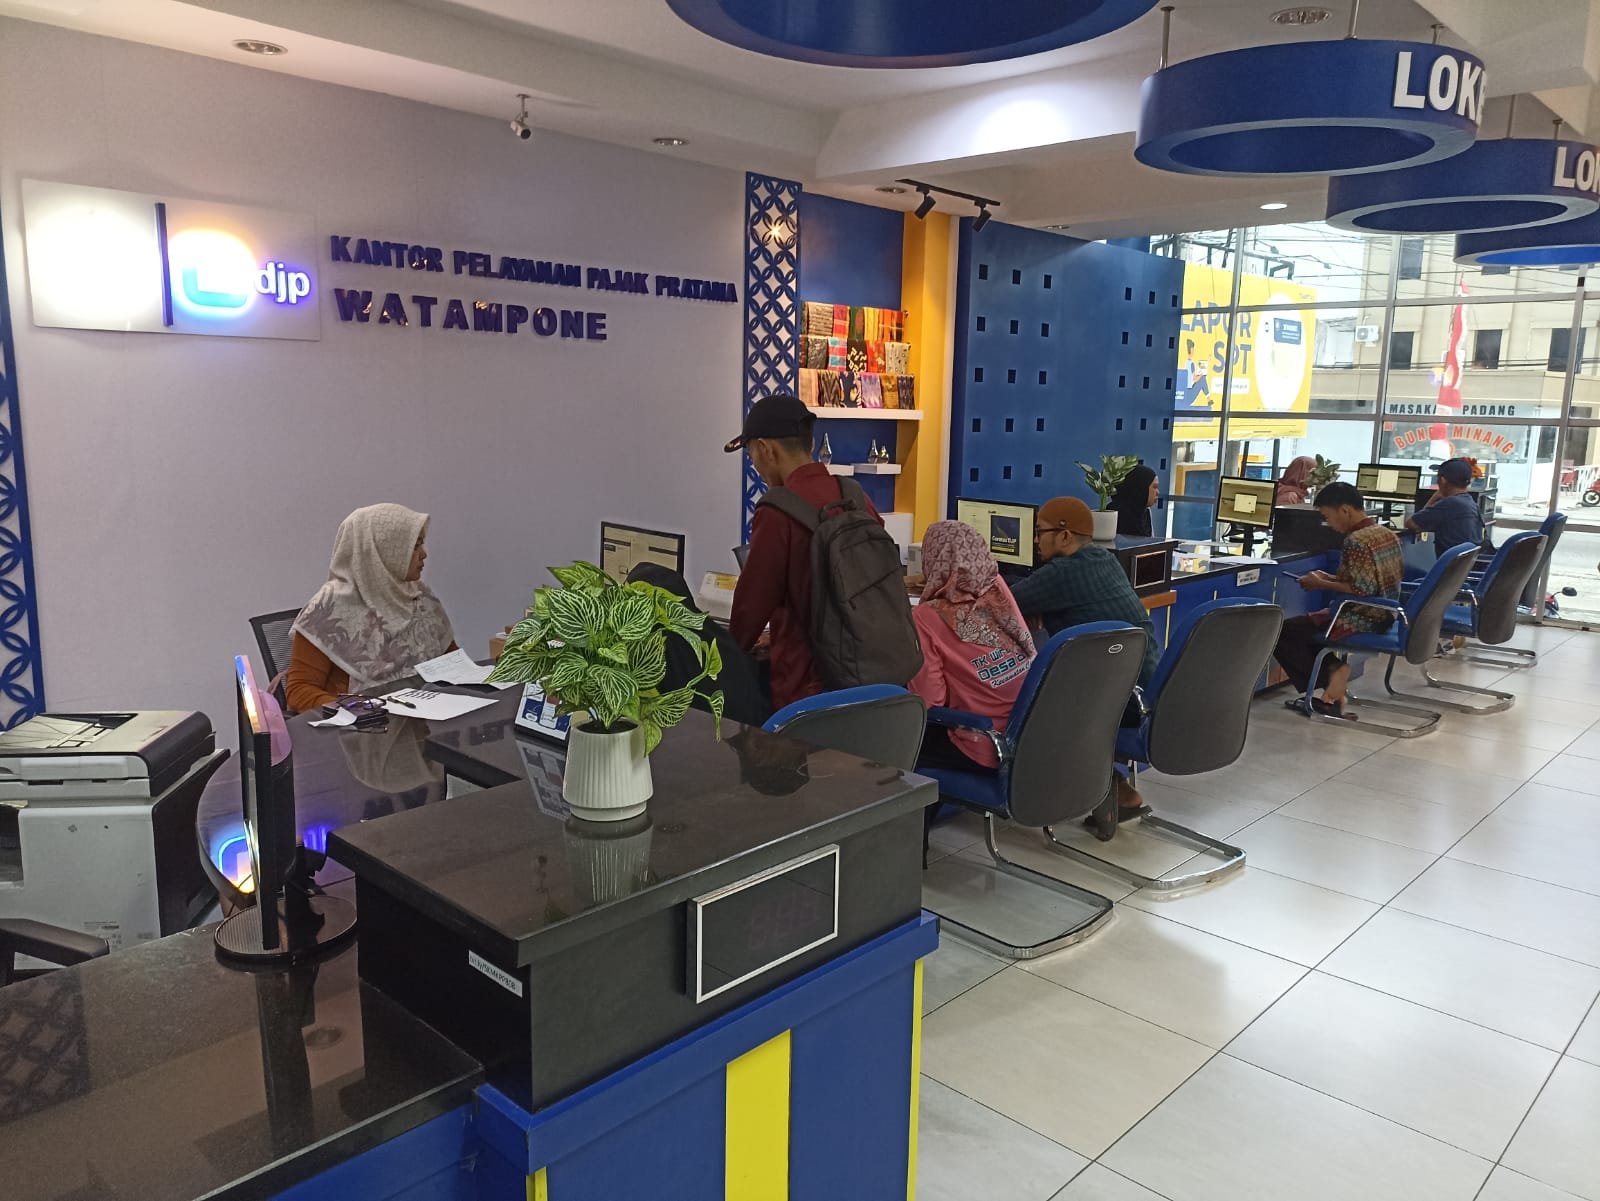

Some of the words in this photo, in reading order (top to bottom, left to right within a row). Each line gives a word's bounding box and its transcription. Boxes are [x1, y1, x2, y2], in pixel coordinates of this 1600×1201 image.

[255, 261, 310, 304] djp
[330, 235, 443, 272] KANTOR
[453, 250, 581, 287] PELAYANAN
[587, 267, 649, 294] PAJAK
[655, 275, 738, 303] PRATAMA
[334, 288, 607, 340] WATAMPONE
[1212, 341, 1251, 375] SPT
[1389, 404, 1437, 415] MASAK
[1462, 405, 1515, 416] PADANG
[1452, 425, 1515, 454] MINANG
[977, 657, 1017, 681] Desa
